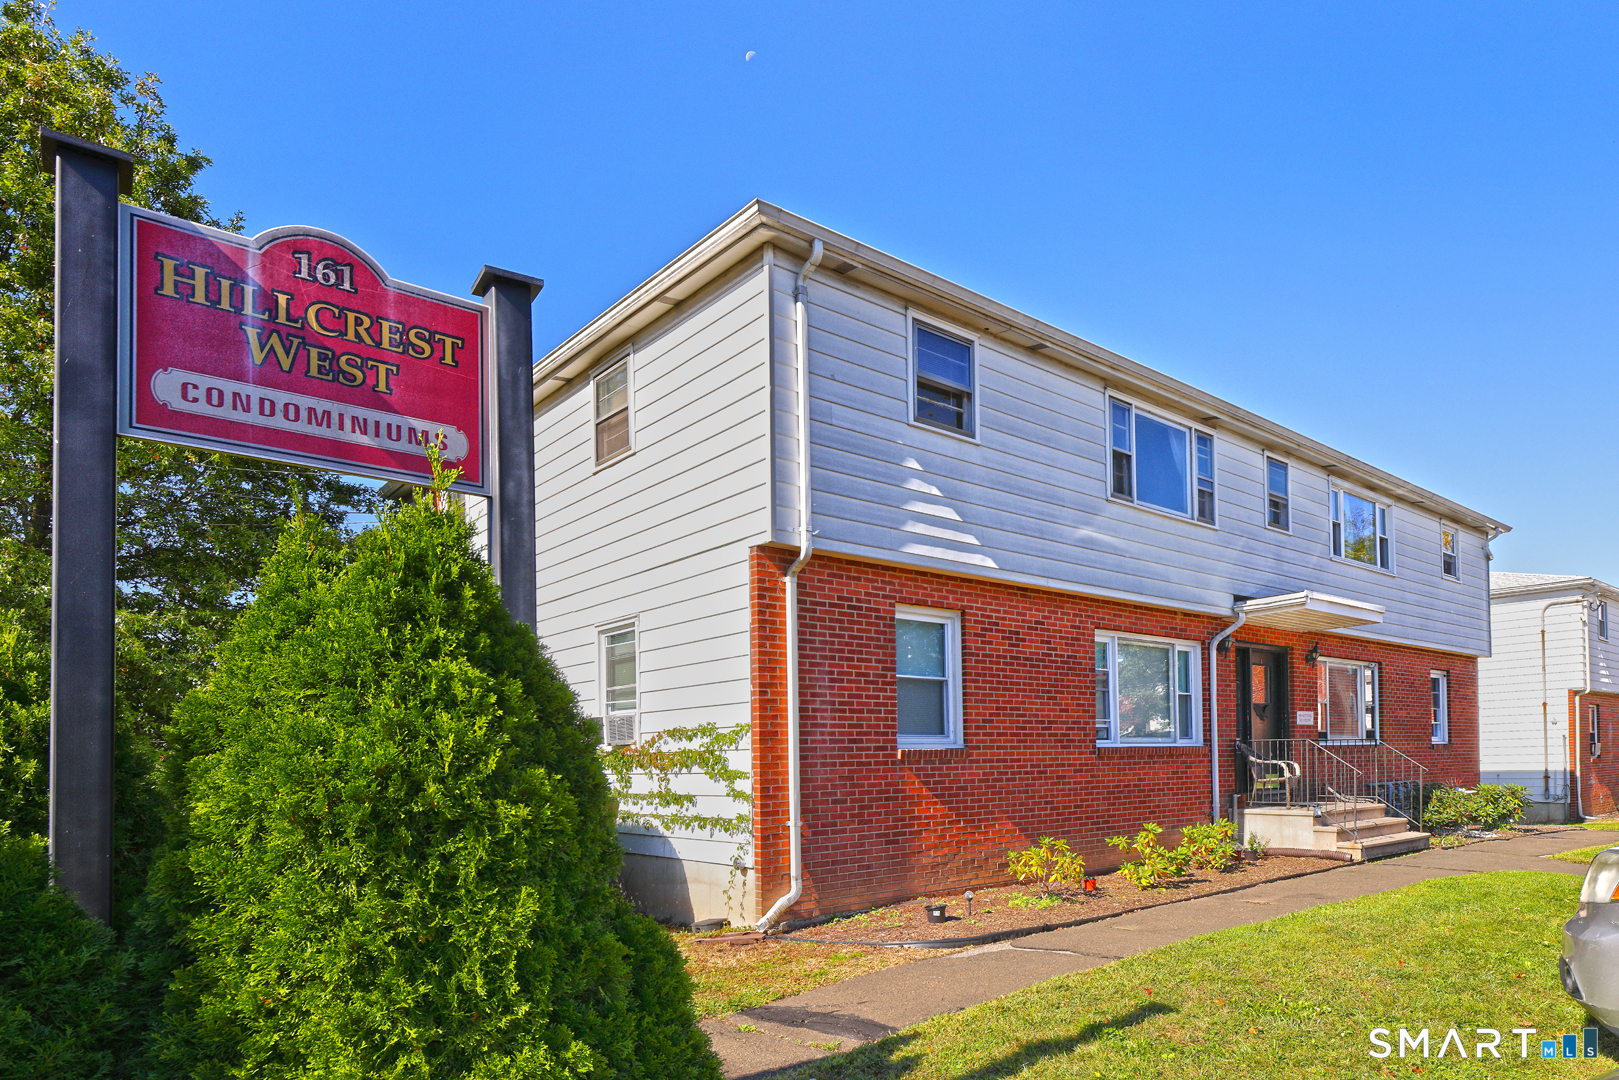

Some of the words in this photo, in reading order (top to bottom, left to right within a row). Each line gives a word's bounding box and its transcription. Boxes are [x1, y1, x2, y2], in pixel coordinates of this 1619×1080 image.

[294, 252, 356, 293] 161
[156, 254, 464, 367] HILLCREST
[239, 321, 399, 395] WEST
[180, 381, 449, 451] CONDOMINIUMS
